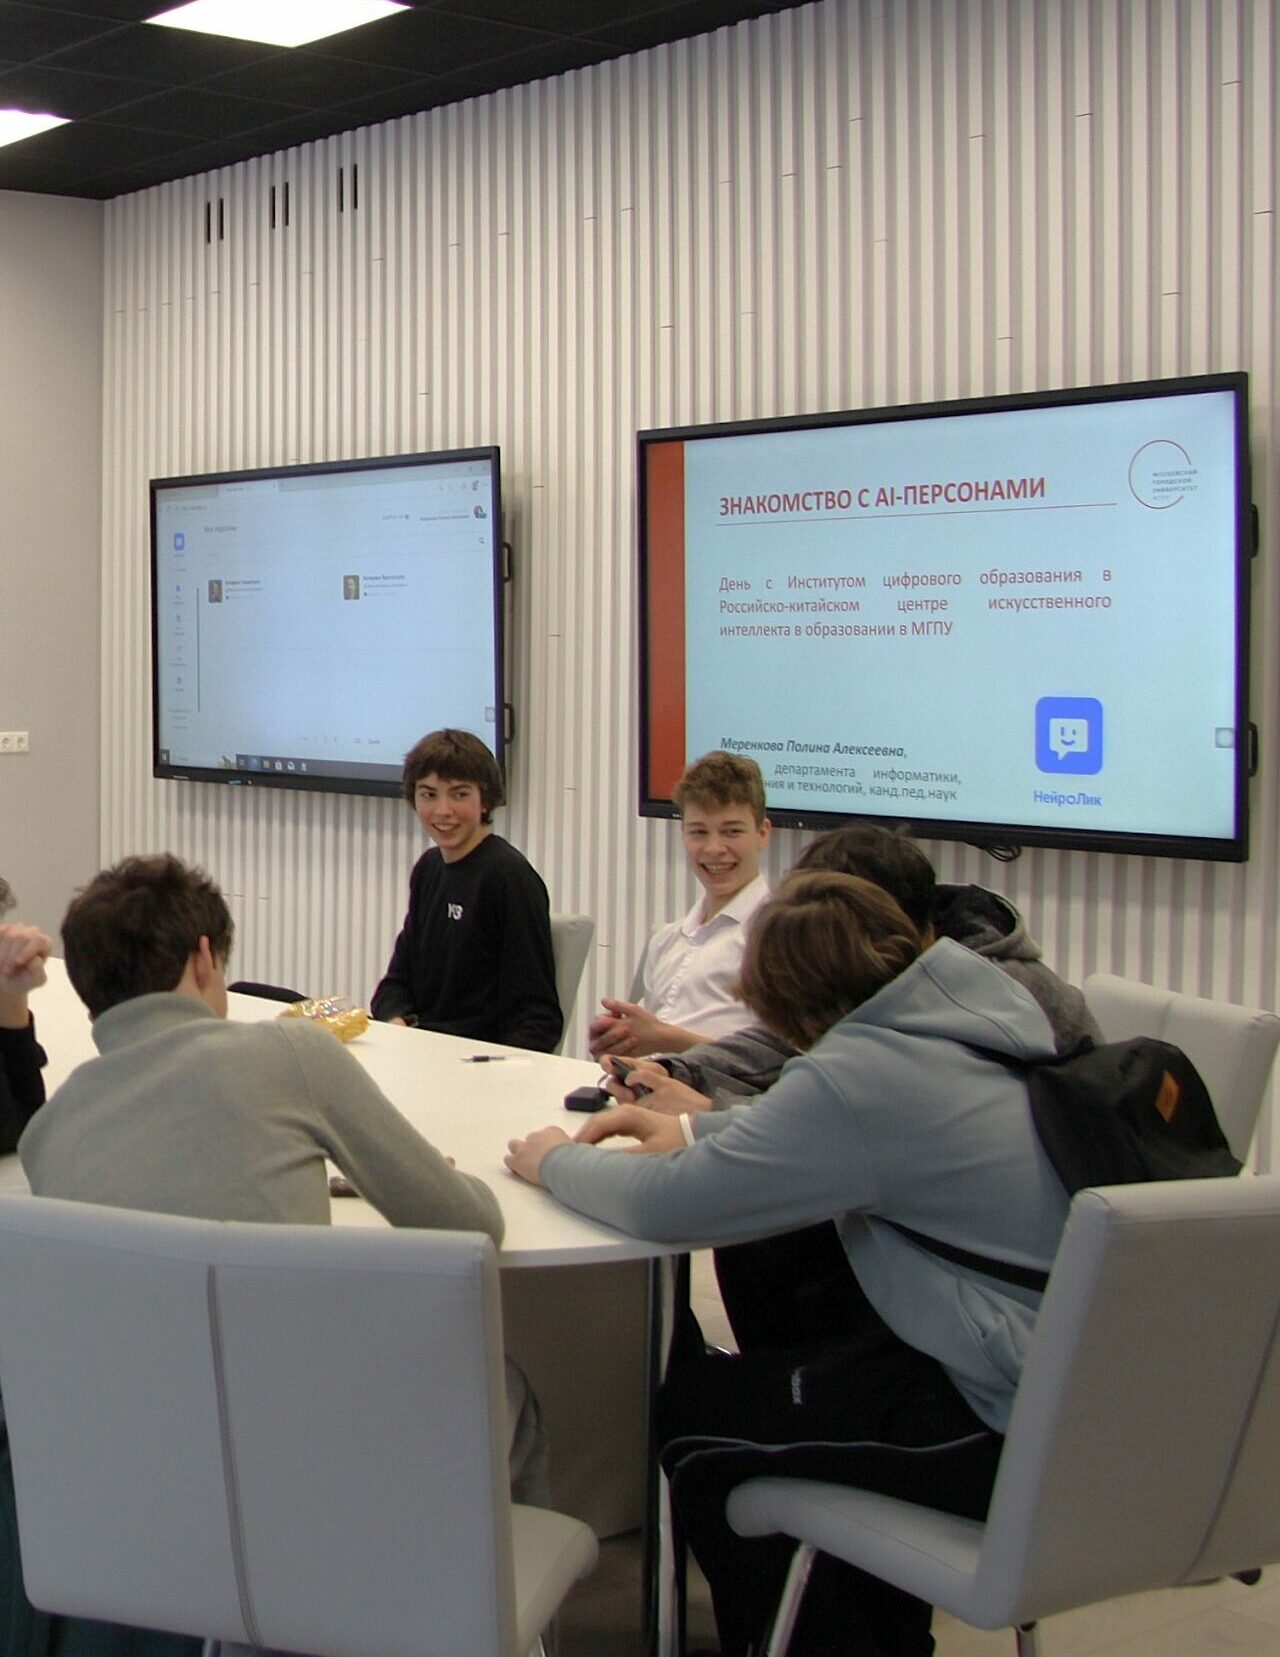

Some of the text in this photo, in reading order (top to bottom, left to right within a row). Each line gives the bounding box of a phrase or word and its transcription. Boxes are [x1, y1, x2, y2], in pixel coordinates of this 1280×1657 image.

[720, 477, 1044, 516] ЗНАКОМСТВО С AI-ПЕРСОНАМИ
[719, 569, 1111, 593] День с Институтом цифрового образования в
[720, 596, 1111, 614] Российско-китайском центре искусственного
[720, 621, 953, 639] интеллекта в образовании в МГПУ
[720, 737, 907, 758] Меренкова Полина Алексеевна,
[774, 763, 962, 784] департамента информатики,
[787, 782, 794, 790] и
[797, 781, 866, 795] технологий,
[1033, 790, 1102, 807] НейроЛик
